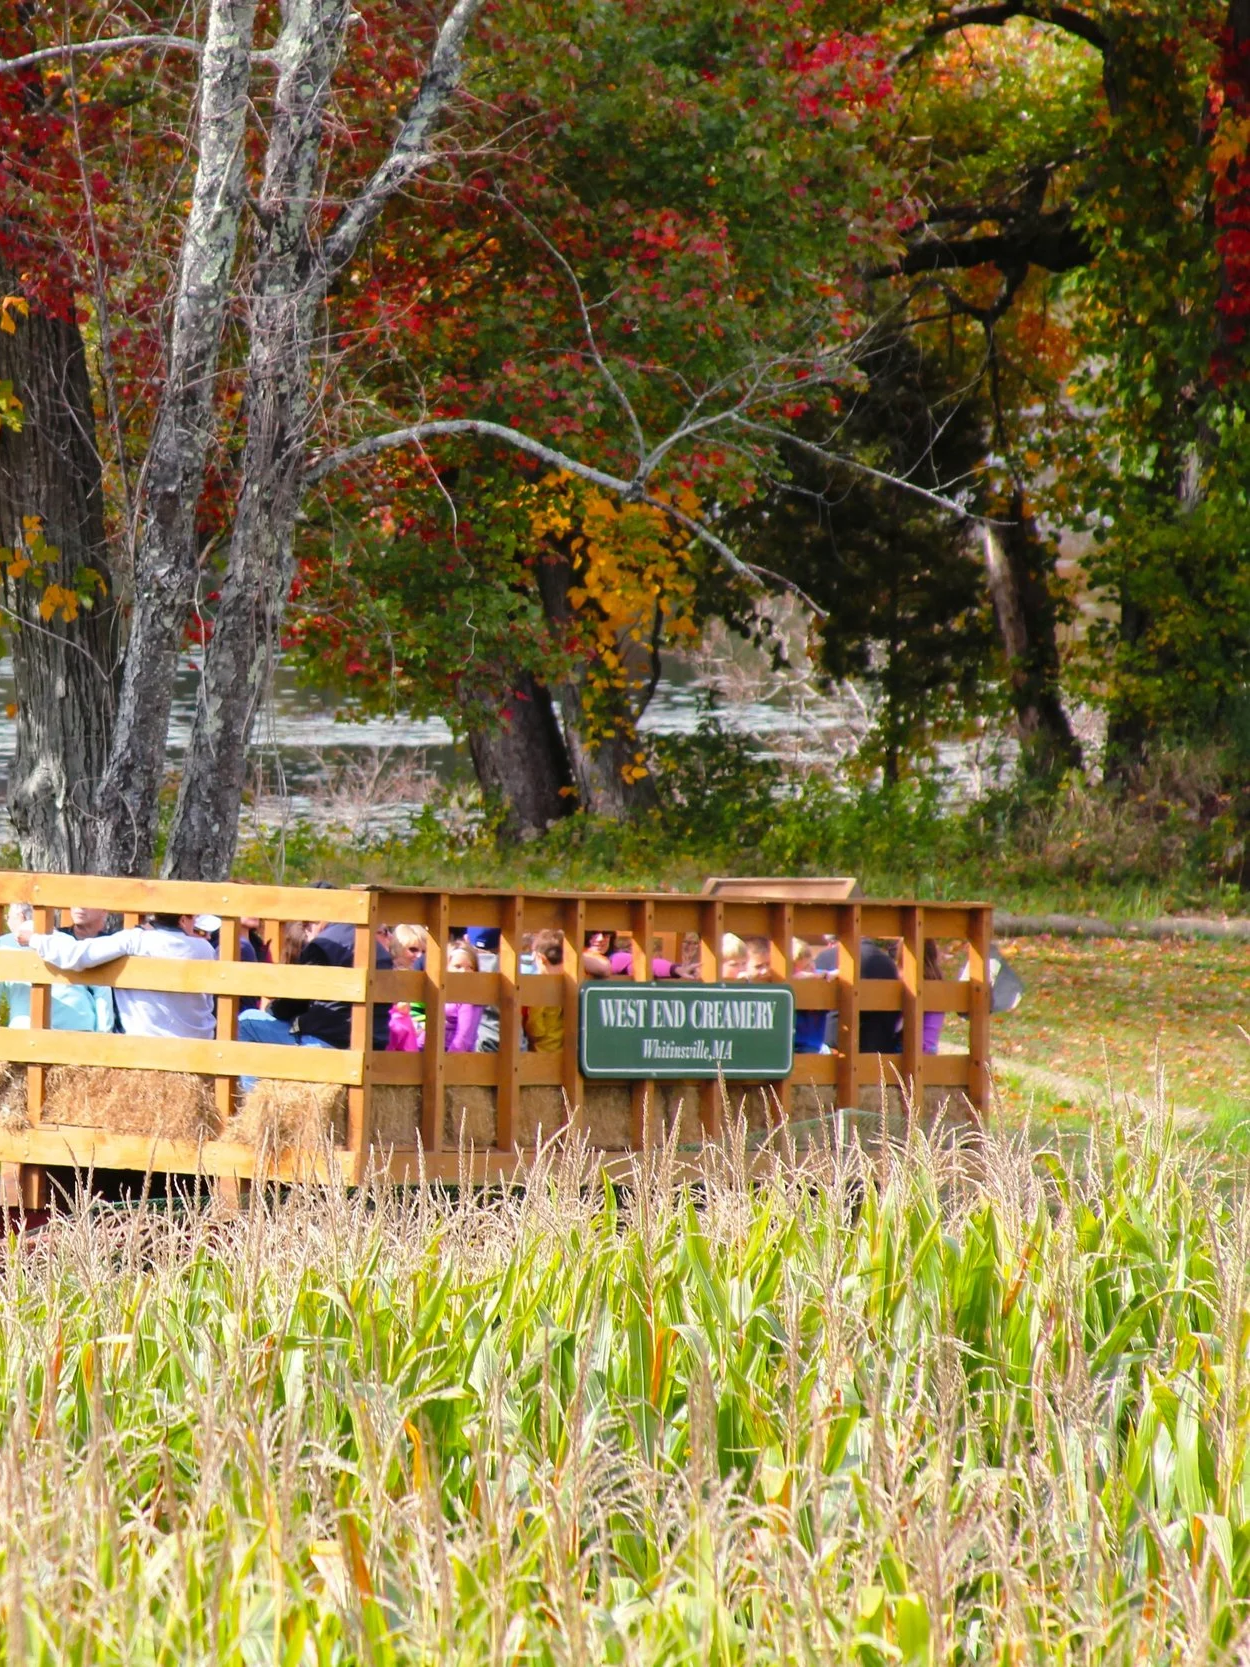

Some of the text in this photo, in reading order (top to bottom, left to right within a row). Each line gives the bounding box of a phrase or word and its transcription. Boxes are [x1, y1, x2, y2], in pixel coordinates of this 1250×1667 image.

[600, 999, 776, 1029] WEST END CREAMERY
